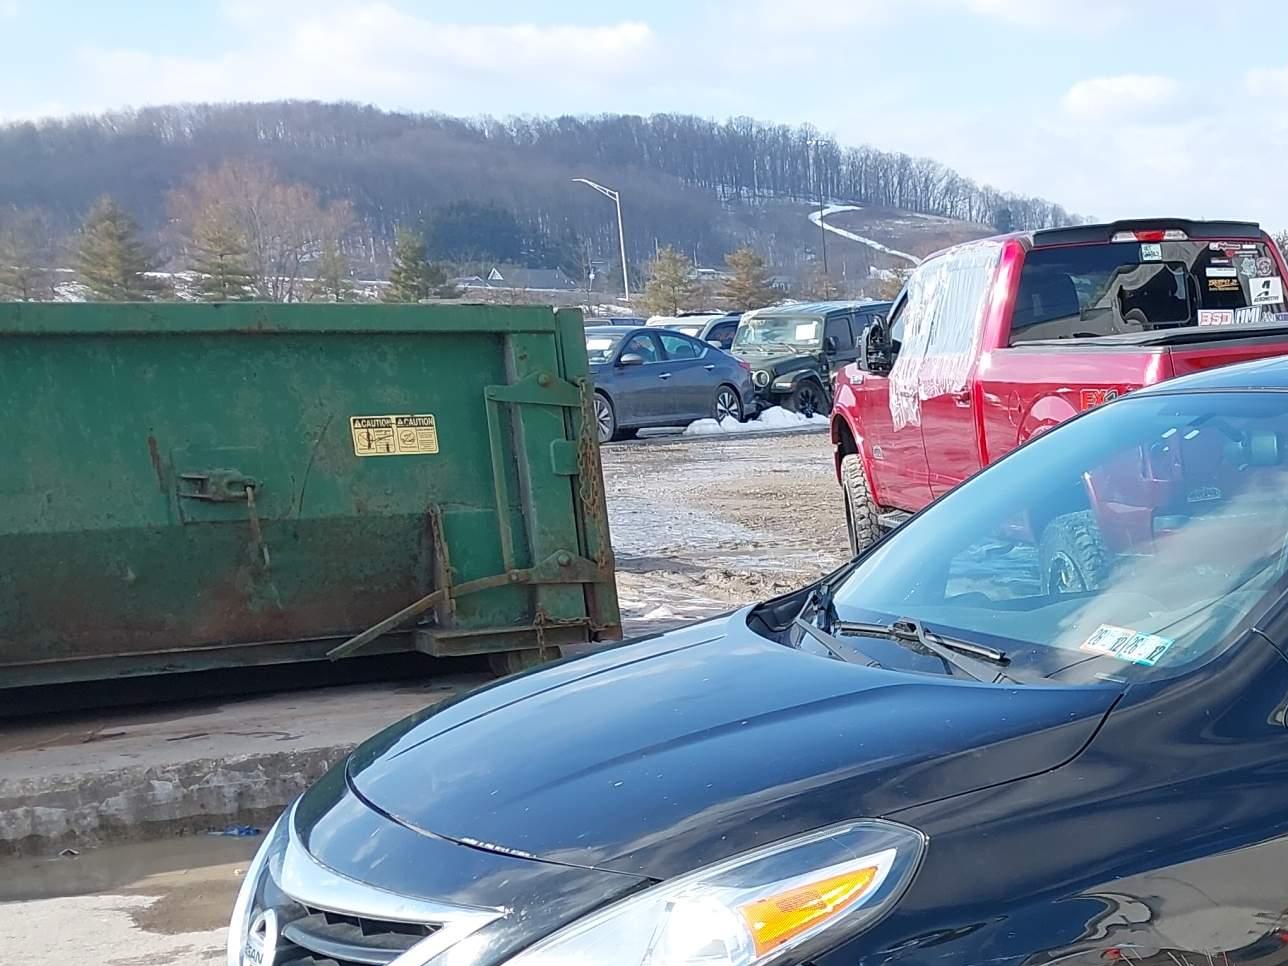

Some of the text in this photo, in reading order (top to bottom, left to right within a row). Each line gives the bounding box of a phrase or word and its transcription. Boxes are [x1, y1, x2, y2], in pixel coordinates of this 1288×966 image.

[1200, 311, 1232, 326] BSD
[361, 418, 393, 427] CAUTION
[403, 416, 434, 426] CAUTION
[1146, 645, 1166, 661] 12
